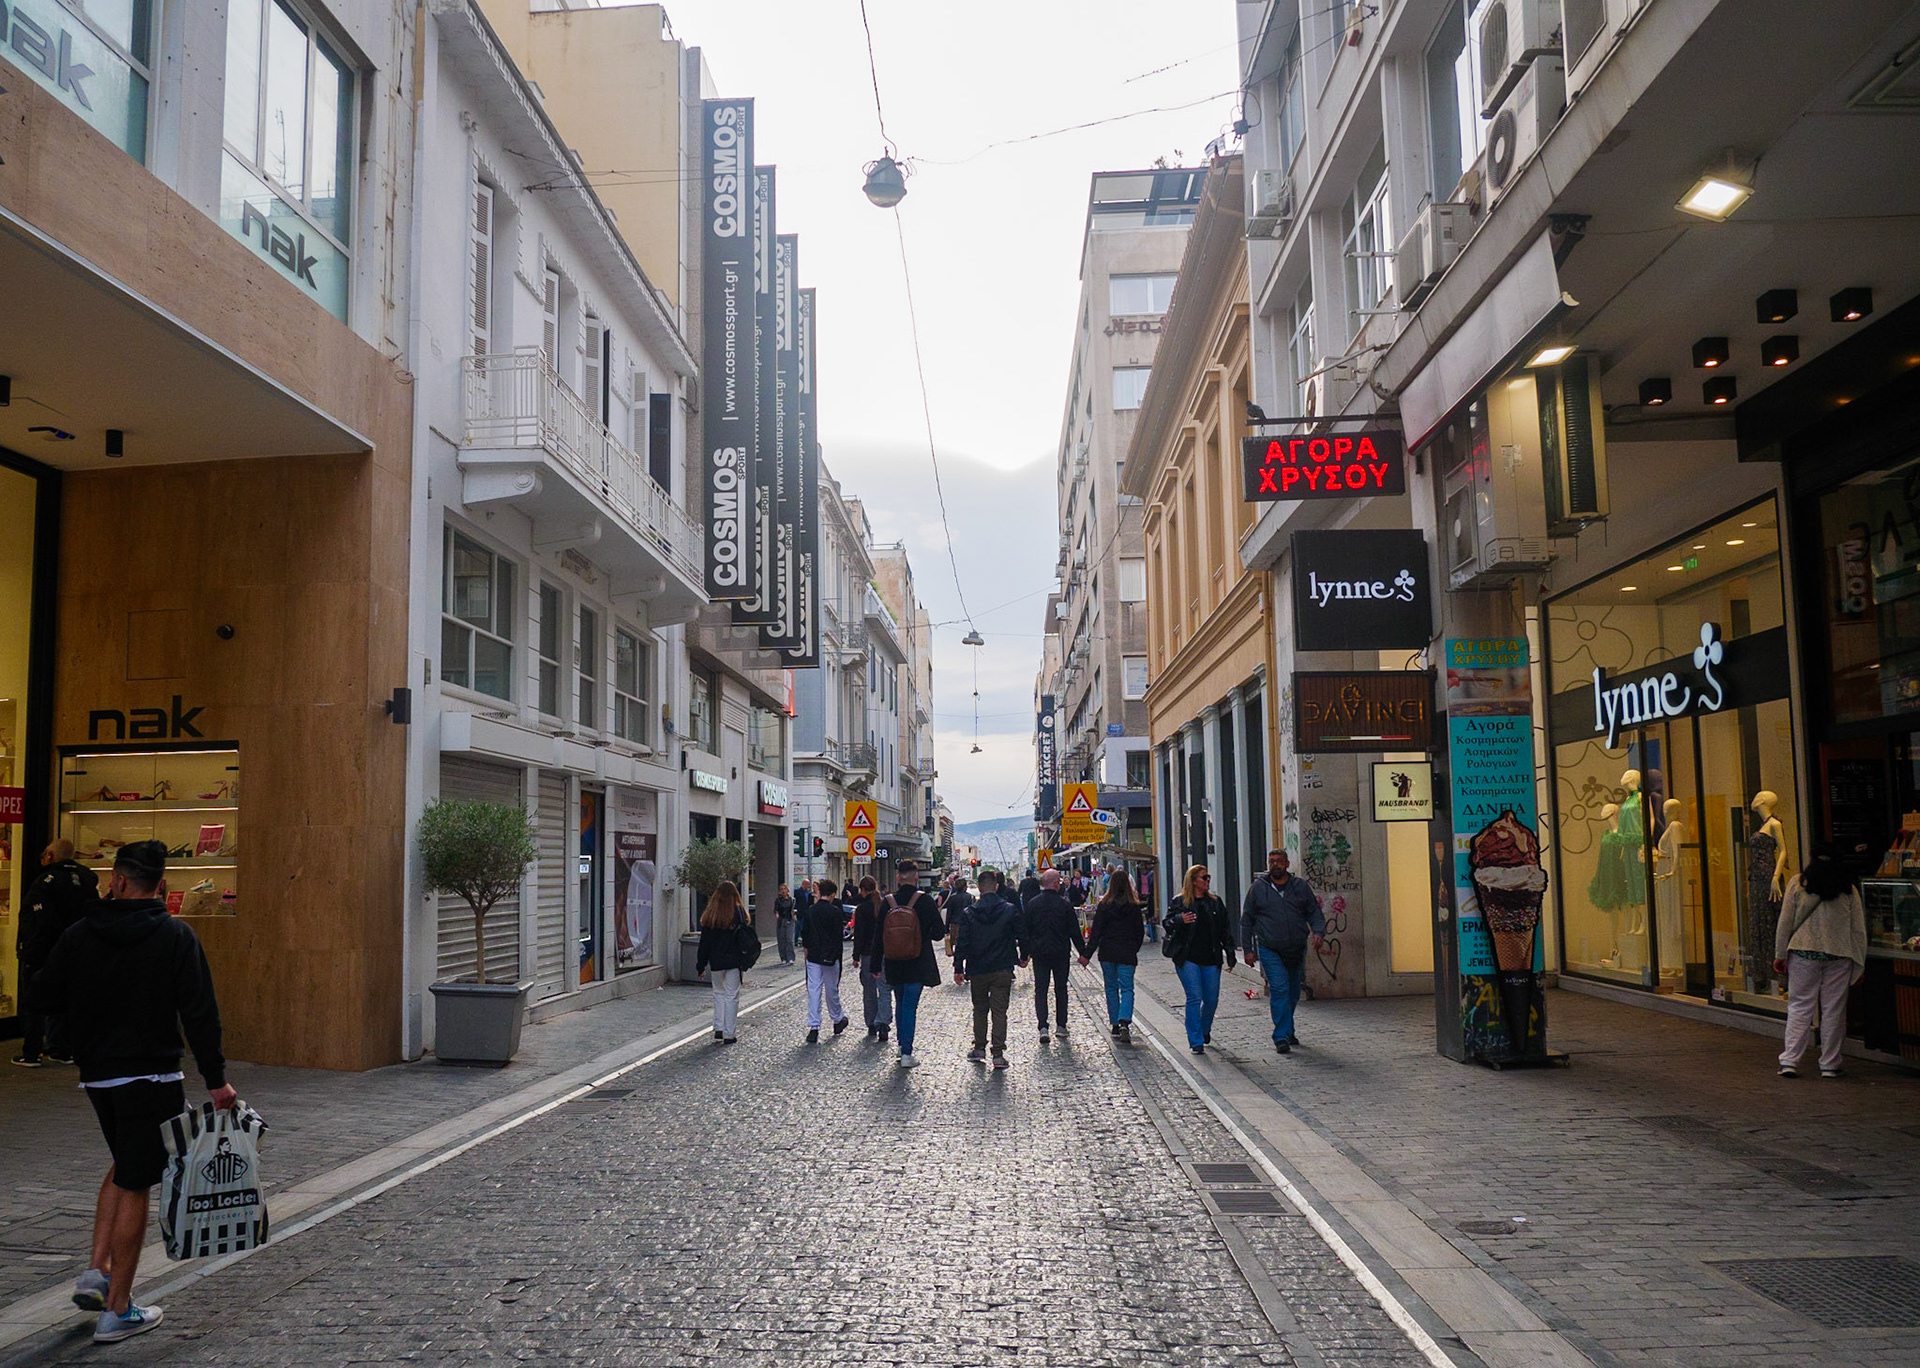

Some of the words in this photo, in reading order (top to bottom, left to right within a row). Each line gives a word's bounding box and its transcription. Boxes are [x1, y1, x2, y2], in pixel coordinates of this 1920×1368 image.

[0, 0, 95, 112] ak
[737, 108, 745, 138] SPORT
[713, 106, 737, 238] COSMOS
[760, 176, 768, 203] SPORT
[242, 200, 318, 291] nak
[723, 269, 738, 412] www.cosmossport.gr
[738, 449, 746, 480] SPORT
[1264, 437, 1378, 465] ΑΓΟΡΑ
[1259, 463, 1388, 493] ΧΡΥΣΟΥ
[713, 447, 738, 587] COSMOS
[1309, 571, 1395, 608] lynne
[1453, 639, 1520, 653] ΑΓΟΡΑ
[1454, 653, 1520, 665] ΧΡΥΣΟΥ
[88, 695, 206, 740] nak
[1304, 697, 1426, 724] DAVINCI
[1593, 667, 1690, 749] lynne
[1465, 718, 1515, 736] Αγορά
[1456, 735, 1525, 749] Κοσμημάτων
[1464, 747, 1519, 758] Ασημικών
[1467, 758, 1517, 770] Ρολογιών
[1456, 774, 1530, 785] ΑΝΤΑΛΛΑΓΗ
[1461, 786, 1527, 797] Κοσμημάτων
[1378, 799, 1429, 807] HAUSBRANDT
[1467, 820, 1478, 830] με
[855, 841, 868, 850] 30
[189, 1196, 214, 1211] Foot
